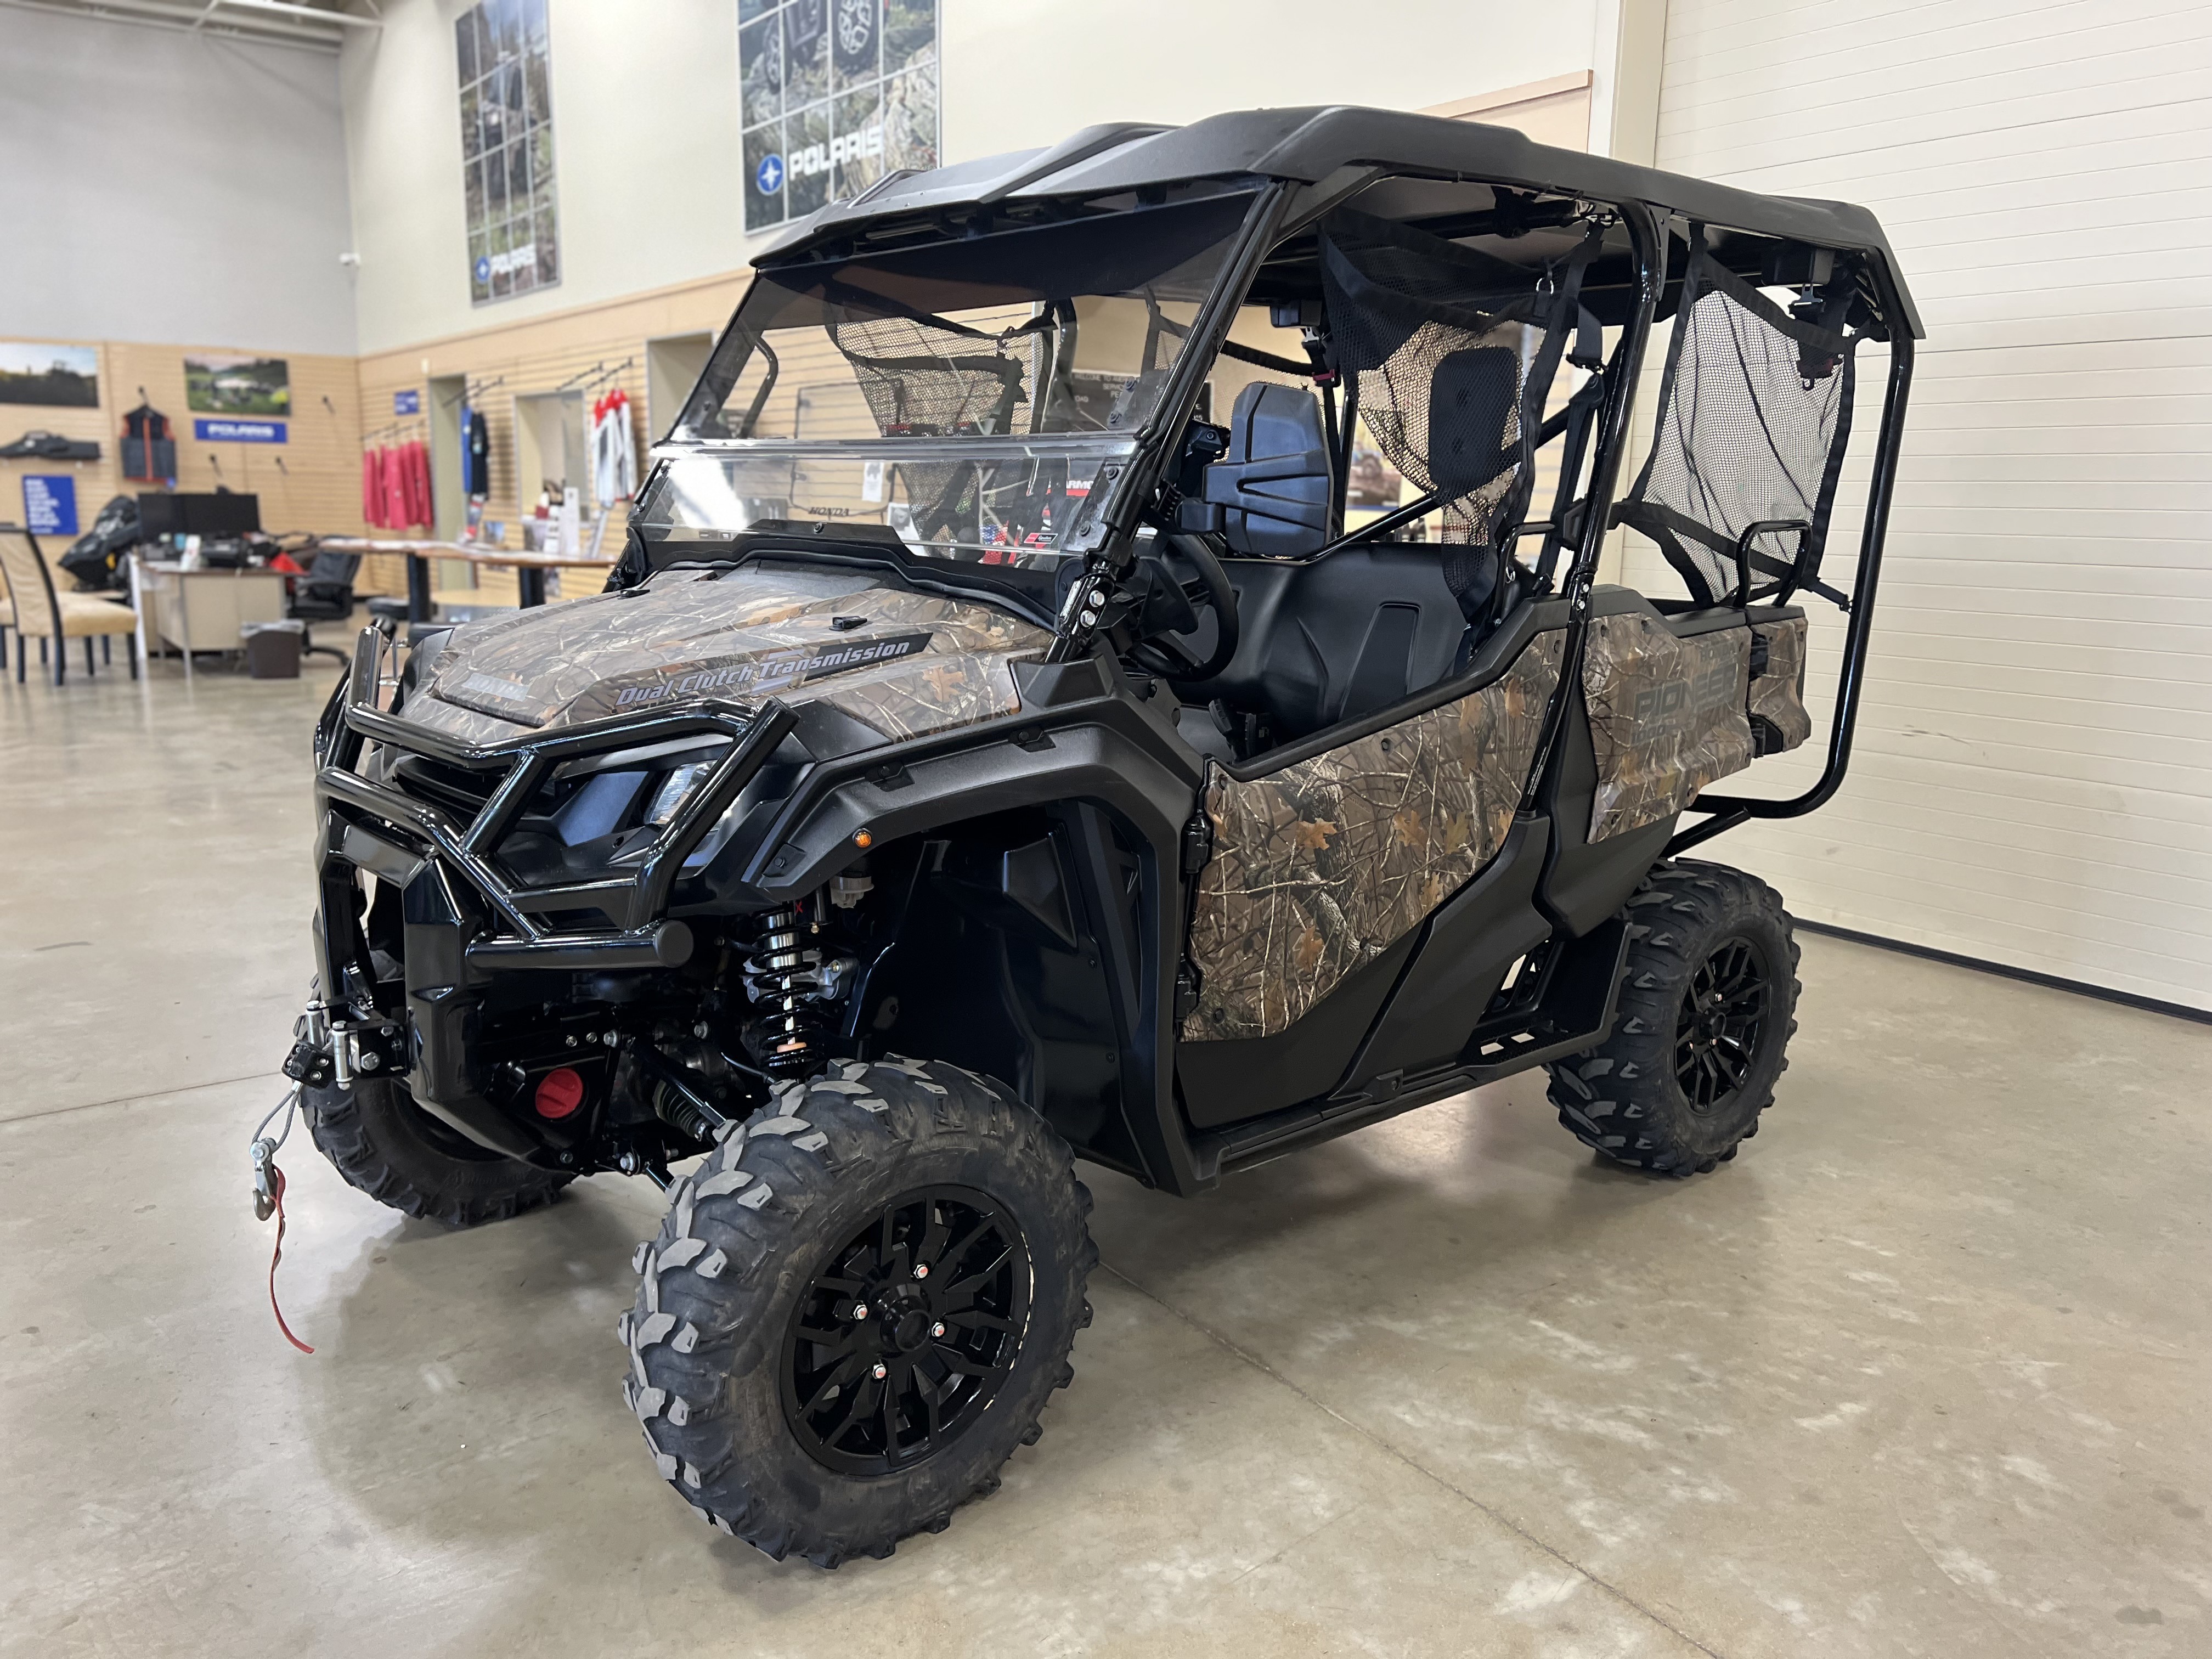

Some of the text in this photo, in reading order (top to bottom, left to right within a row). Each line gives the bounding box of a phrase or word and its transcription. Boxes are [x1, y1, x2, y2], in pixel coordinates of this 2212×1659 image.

[788, 125, 883, 181] POLARIS
[207, 423, 275, 438] POLARIS
[808, 507, 849, 516] HONDA
[615, 641, 911, 706] Dual Clutch Transmission
[1633, 662, 1737, 722] PIONEER
